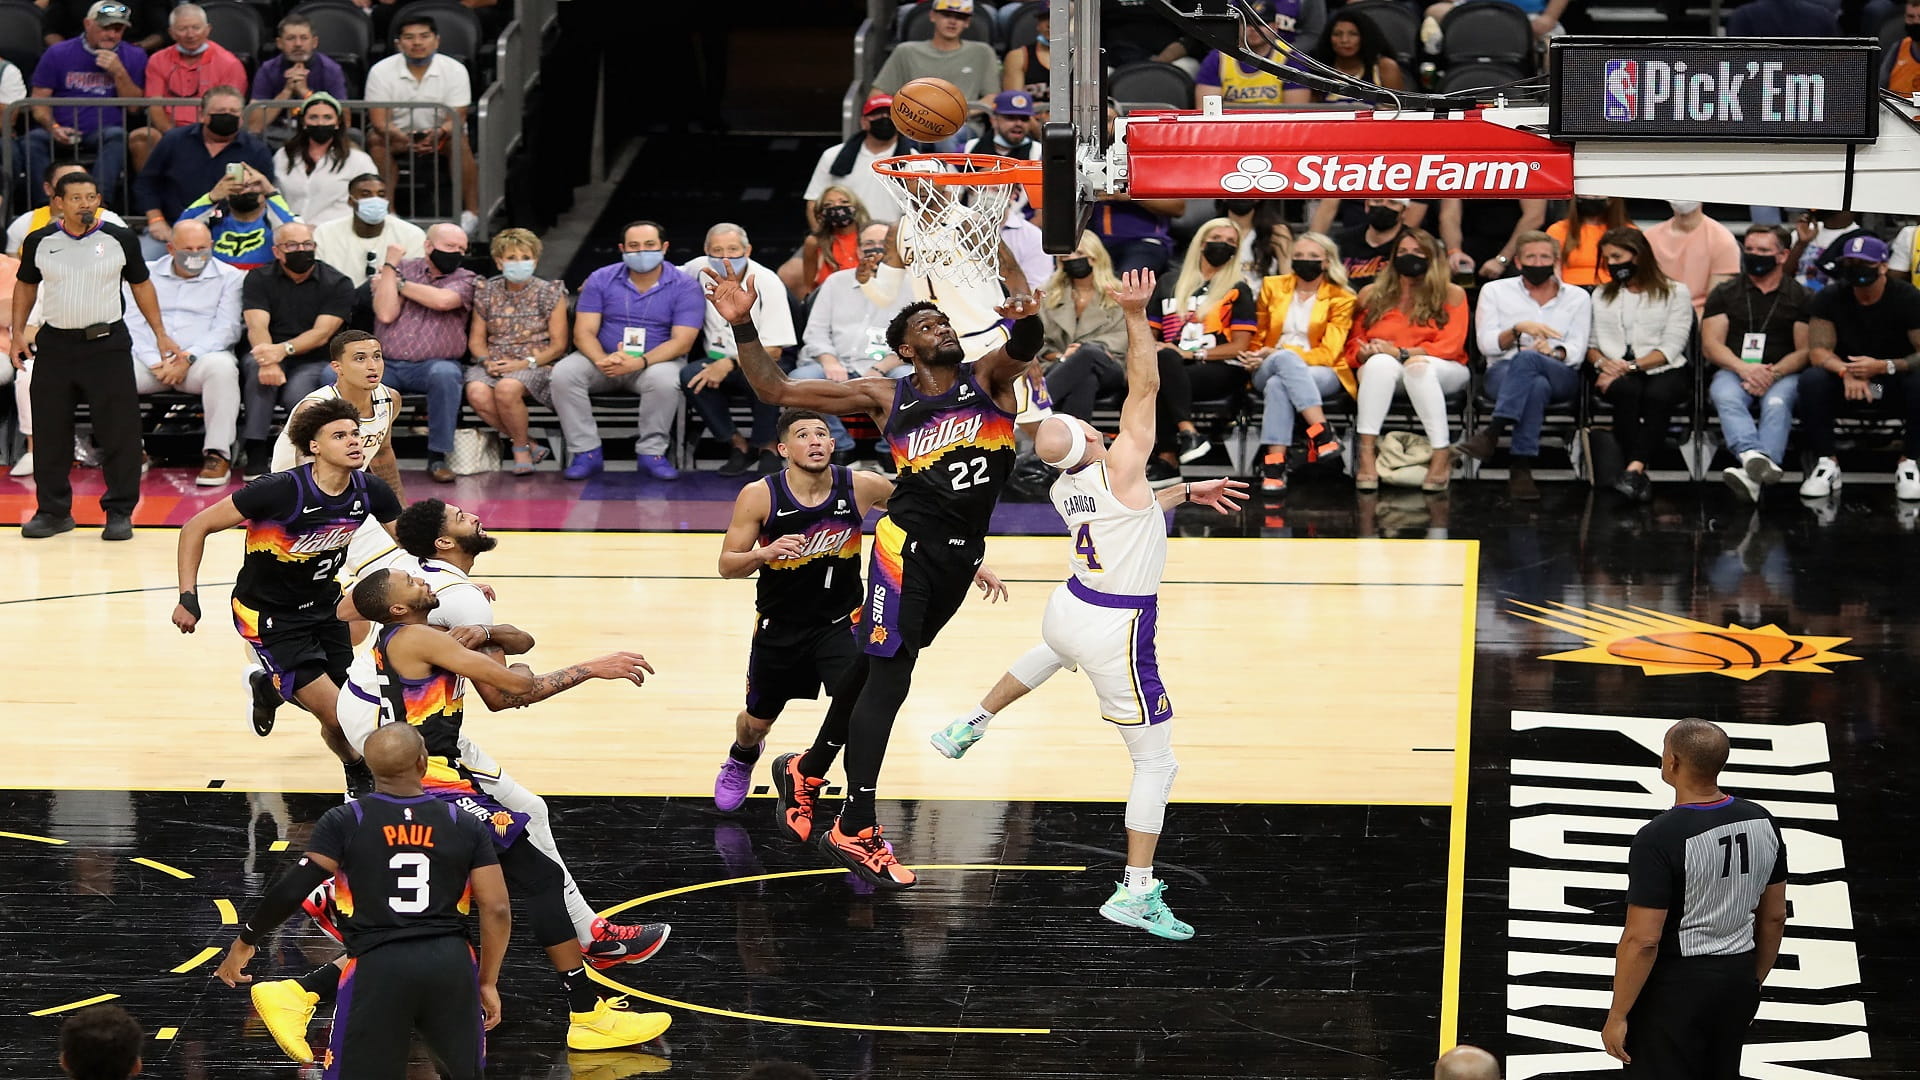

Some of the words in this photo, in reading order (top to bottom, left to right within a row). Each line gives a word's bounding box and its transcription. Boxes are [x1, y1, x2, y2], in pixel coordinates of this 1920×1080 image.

[1224, 85, 1278, 102] LAKERS
[896, 102, 945, 134] SPALDING
[907, 413, 983, 461] Valley
[948, 456, 990, 491] 22
[1063, 495, 1097, 517] CARUSO
[777, 527, 852, 560] lley
[1074, 521, 1105, 573] 4
[824, 566, 834, 589] 1
[872, 583, 886, 625] SUNS
[383, 824, 435, 848] PAUL
[1718, 832, 1750, 879] 71
[388, 852, 431, 913] 3
